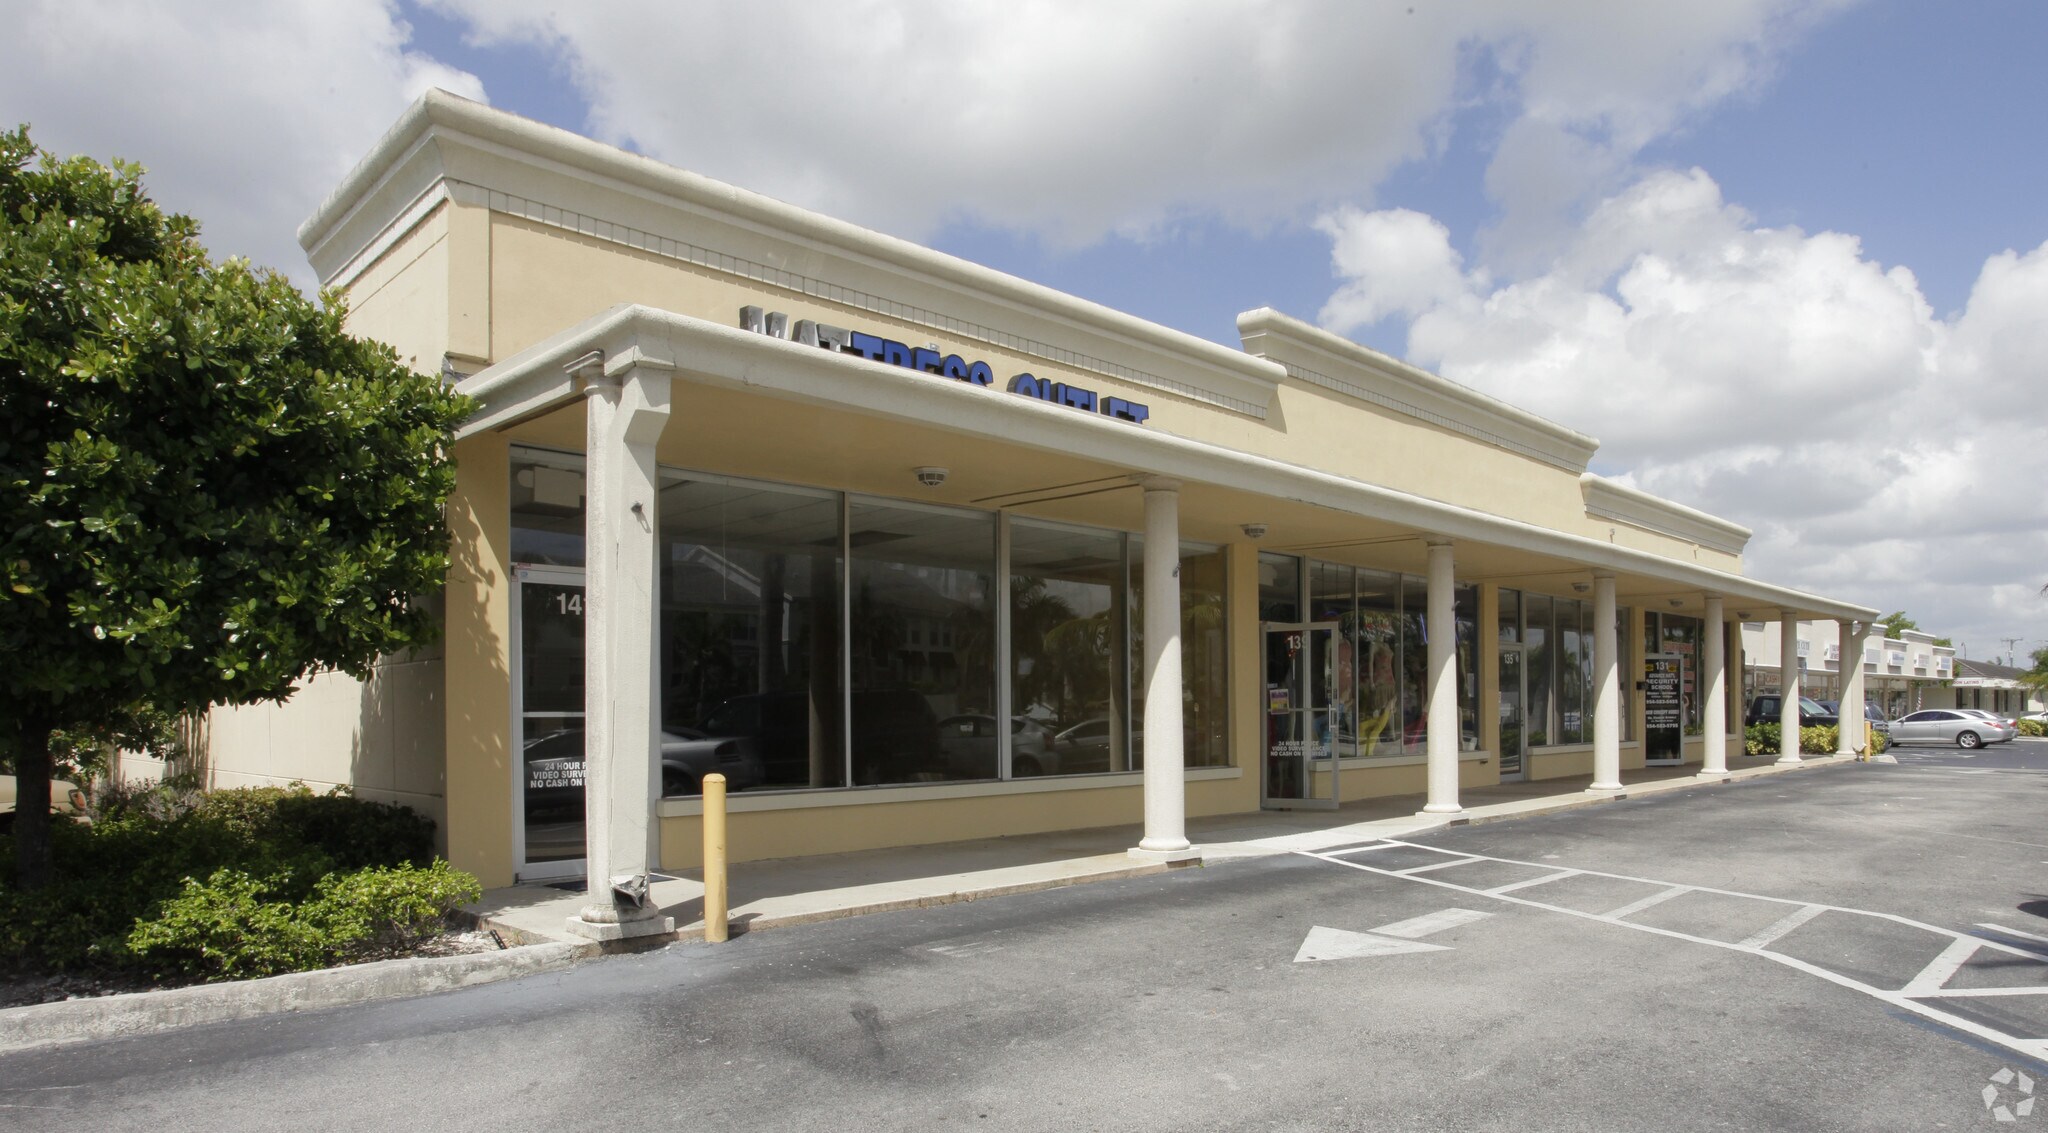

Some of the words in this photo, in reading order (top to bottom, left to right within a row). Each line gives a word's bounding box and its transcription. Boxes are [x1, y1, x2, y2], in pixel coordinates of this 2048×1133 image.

[556, 592, 586, 616] 14
[1656, 662, 1669, 670] 131
[544, 763, 555, 771] 24
[557, 762, 580, 770] HOUR
[533, 771, 559, 779] VIDEO
[530, 780, 544, 788] NO
[546, 779, 568, 788] CASH
[570, 778, 582, 787] ON
